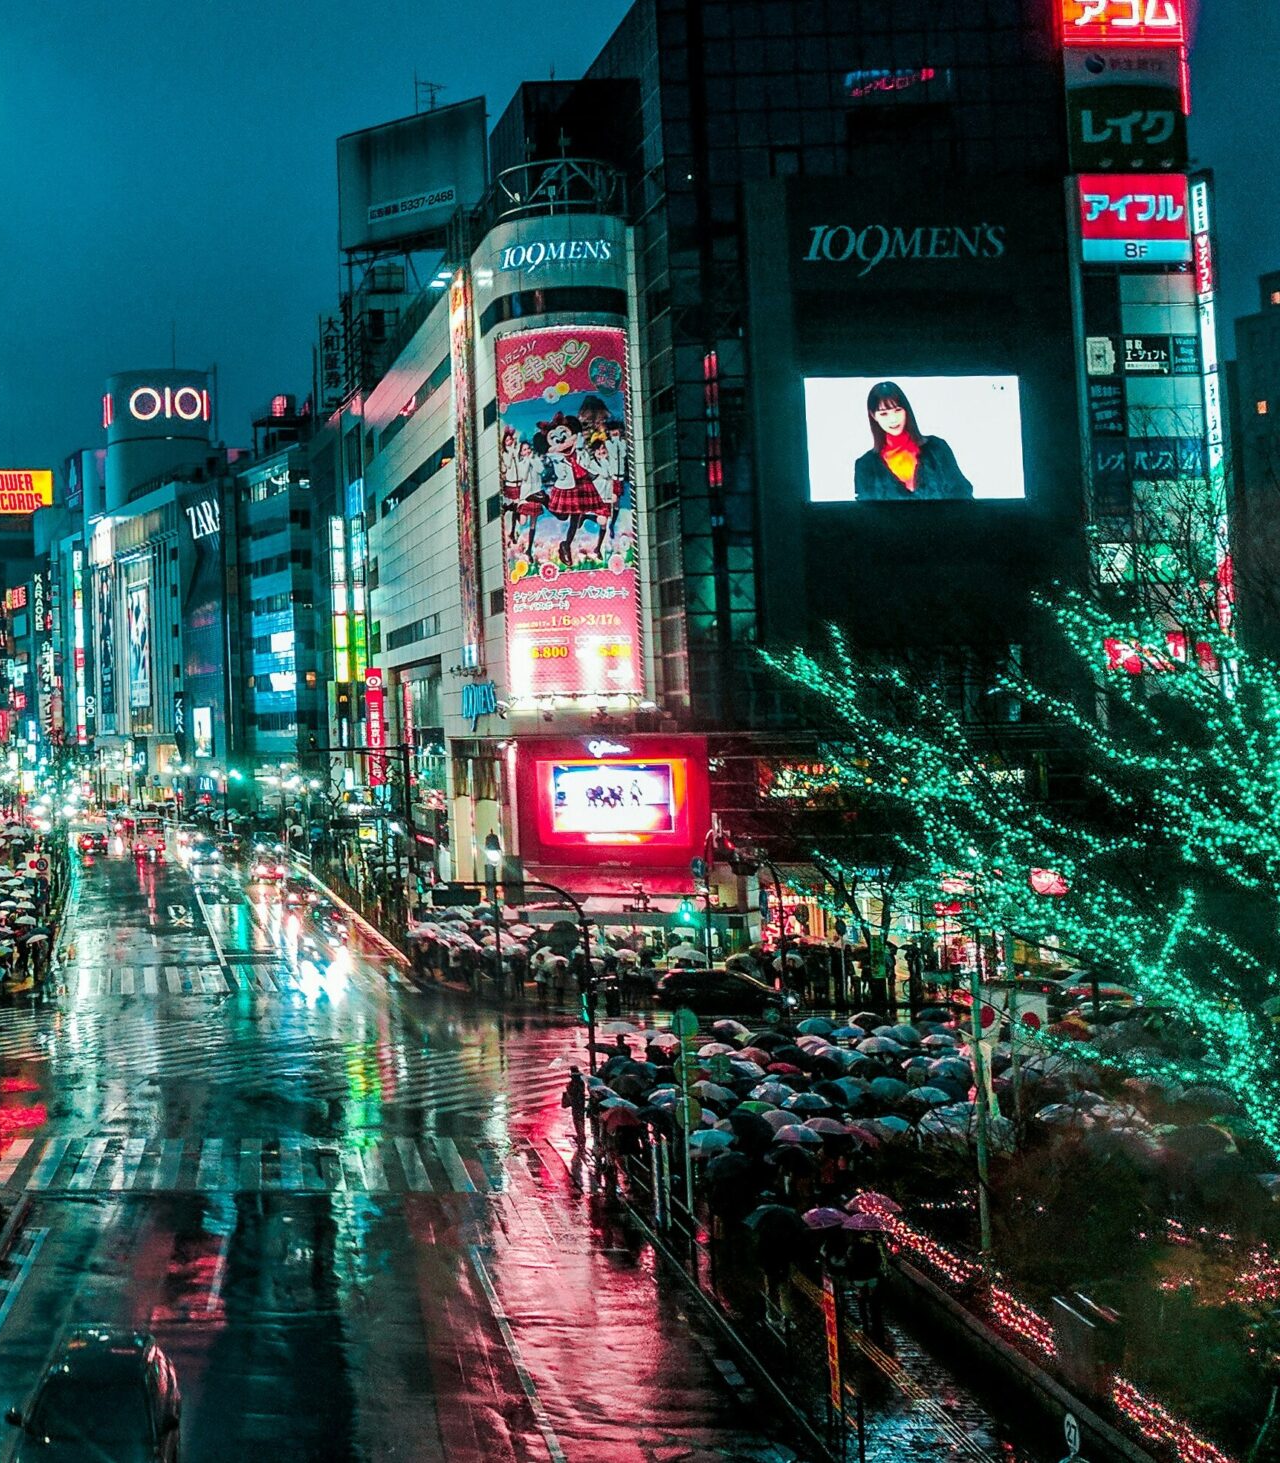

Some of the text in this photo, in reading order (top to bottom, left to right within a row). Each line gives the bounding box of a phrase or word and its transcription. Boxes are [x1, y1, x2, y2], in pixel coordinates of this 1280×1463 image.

[1074, 0, 1178, 26] アコム
[1081, 110, 1175, 144] レイク
[1084, 194, 1183, 222] アイフル
[502, 239, 611, 272] 109MEN'S
[803, 222, 1006, 277] 109MEN'S
[1125, 243, 1148, 258] 8F
[1199, 248, 1210, 292] アイフル
[34, 573, 44, 631] KARAOKE
[175, 699, 184, 733] ZARA
[1066, 1420, 1077, 1447] 27
